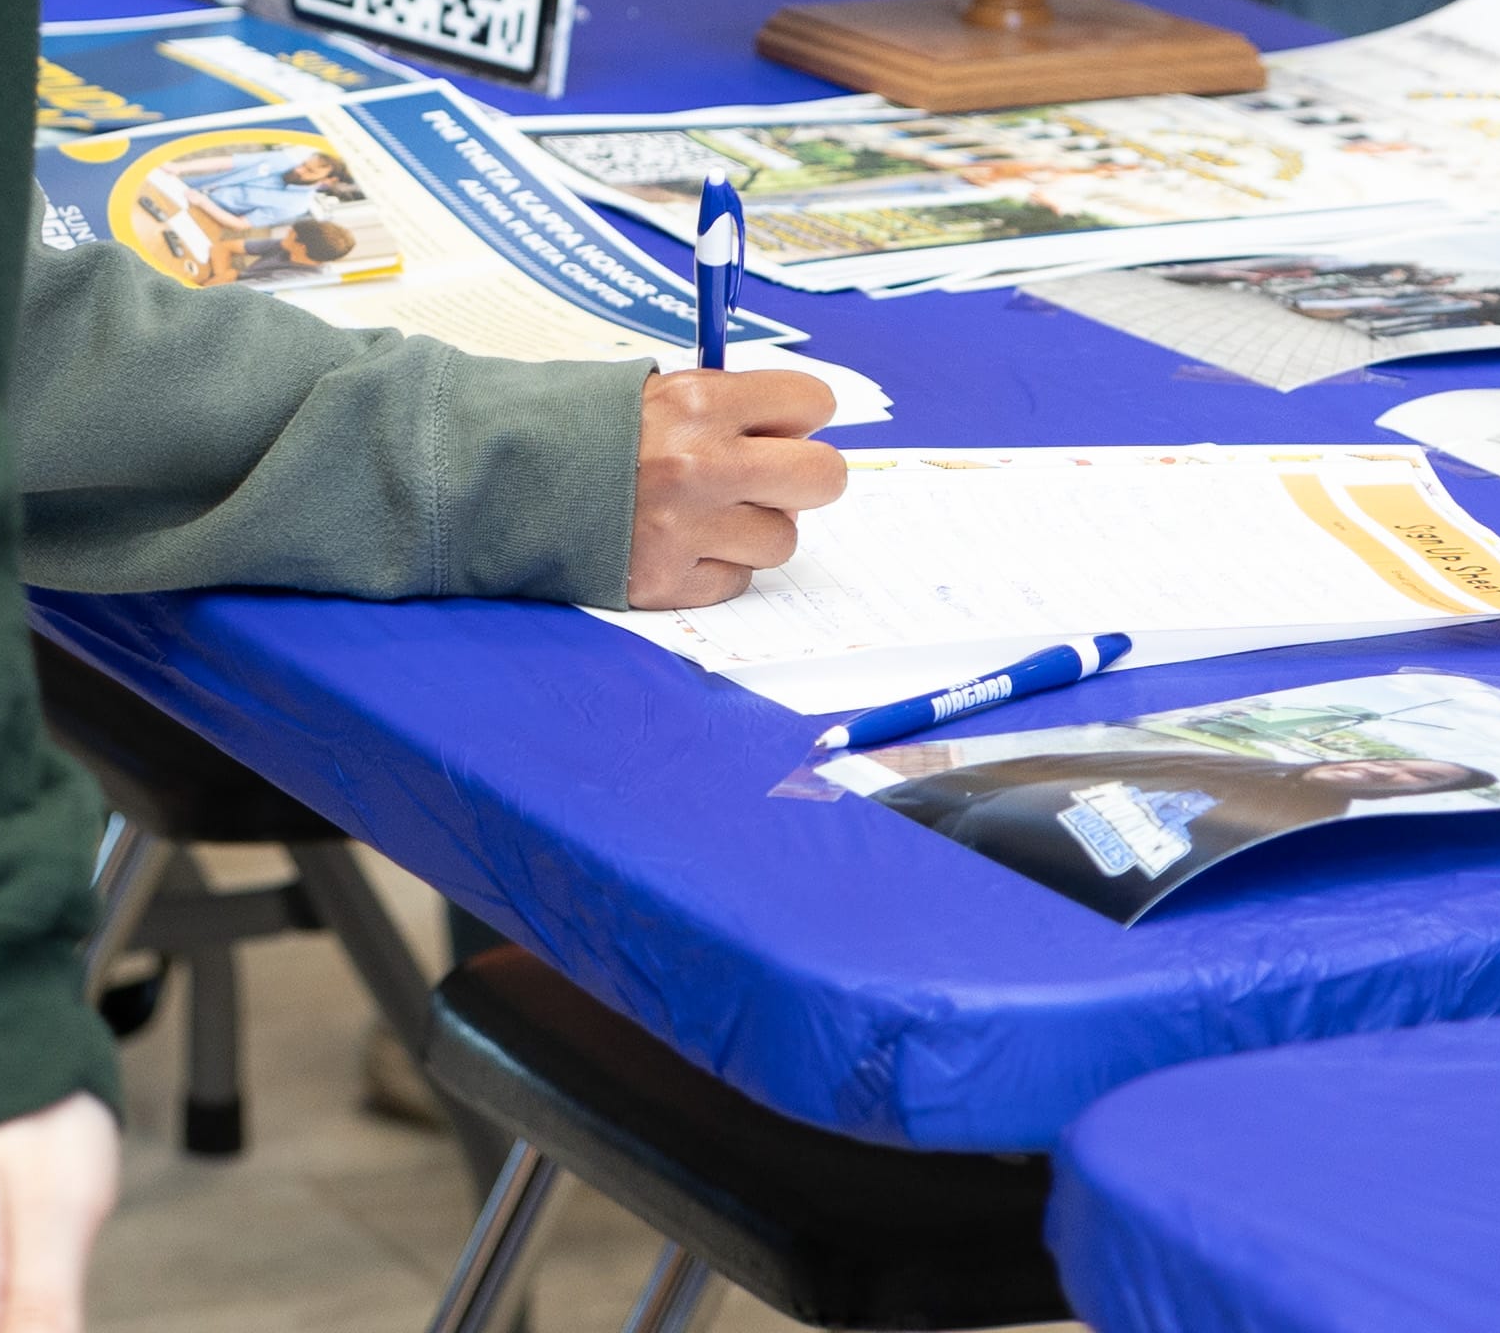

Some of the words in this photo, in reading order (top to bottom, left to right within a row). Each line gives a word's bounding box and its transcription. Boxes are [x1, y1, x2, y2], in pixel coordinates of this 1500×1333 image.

[421, 109, 469, 143] PHI
[454, 137, 522, 194] THETA
[508, 189, 586, 249] KAPPA
[573, 243, 659, 298] HONOR
[457, 178, 516, 224] ALPHA
[505, 219, 534, 239] PI
[520, 232, 567, 267] BETA
[559, 261, 636, 309] CHAPTER
[1393, 523, 1445, 547] Sign
[1425, 546, 1472, 564] Up
[930, 673, 1013, 724] NIAGARA
